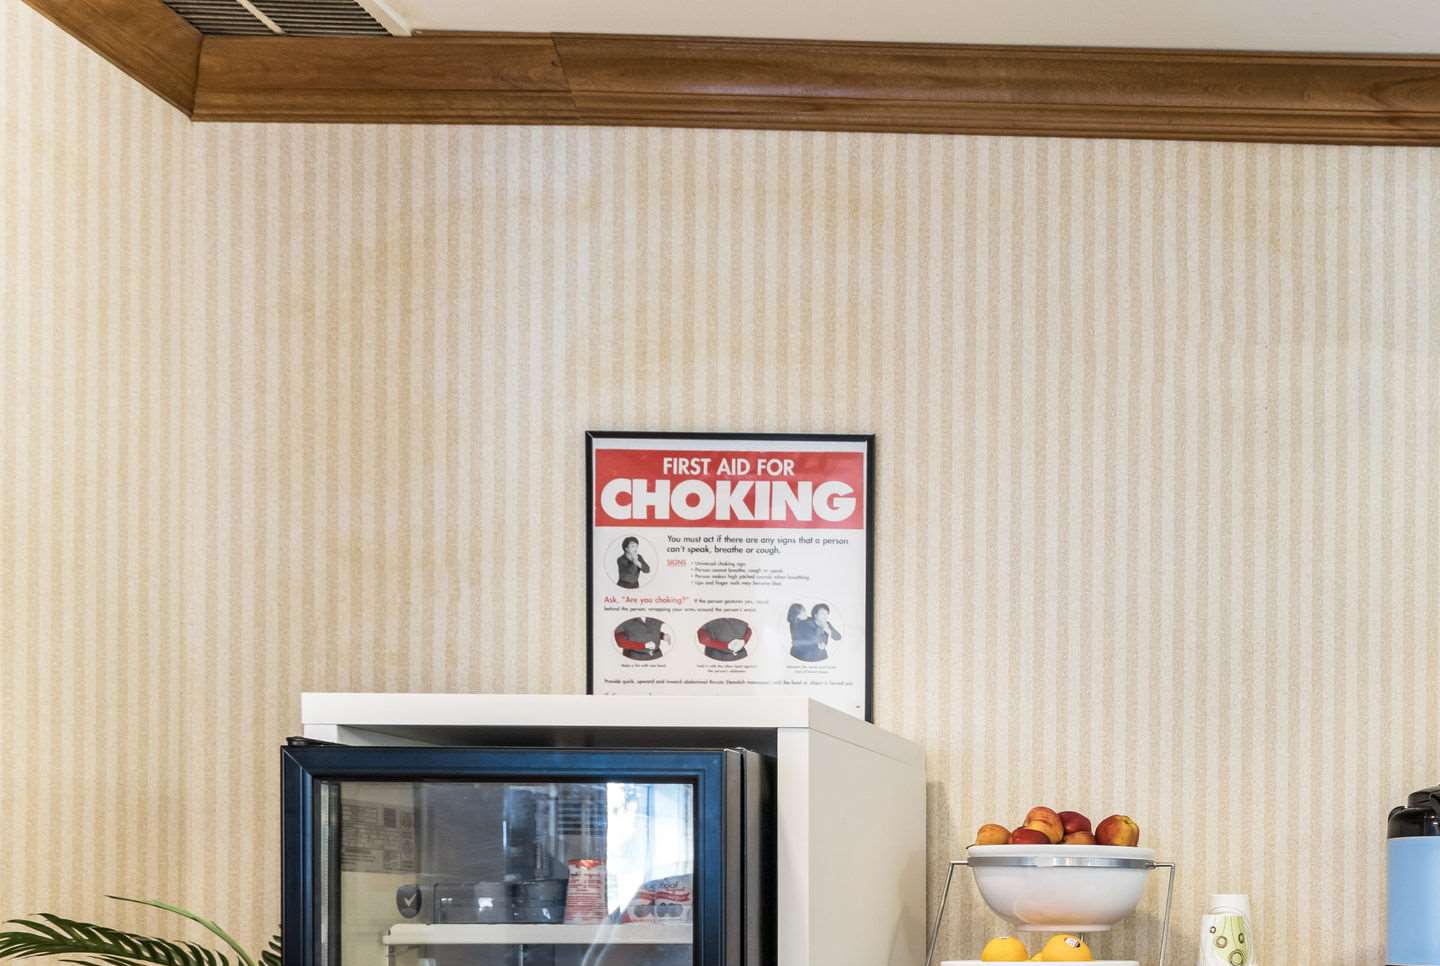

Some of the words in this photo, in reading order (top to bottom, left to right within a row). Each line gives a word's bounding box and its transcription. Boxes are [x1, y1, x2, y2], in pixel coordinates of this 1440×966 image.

[663, 457, 711, 475] FIRST
[717, 458, 750, 476] AID
[758, 459, 794, 476] FOR
[600, 478, 857, 522] CHOKING
[667, 535, 681, 543] You
[716, 535, 722, 543] if
[724, 535, 743, 543] there
[760, 537, 774, 545] any
[777, 537, 796, 546] signs
[799, 536, 814, 544] that
[822, 538, 849, 546] person
[714, 546, 743, 554] breathe
[756, 547, 781, 555] cough.
